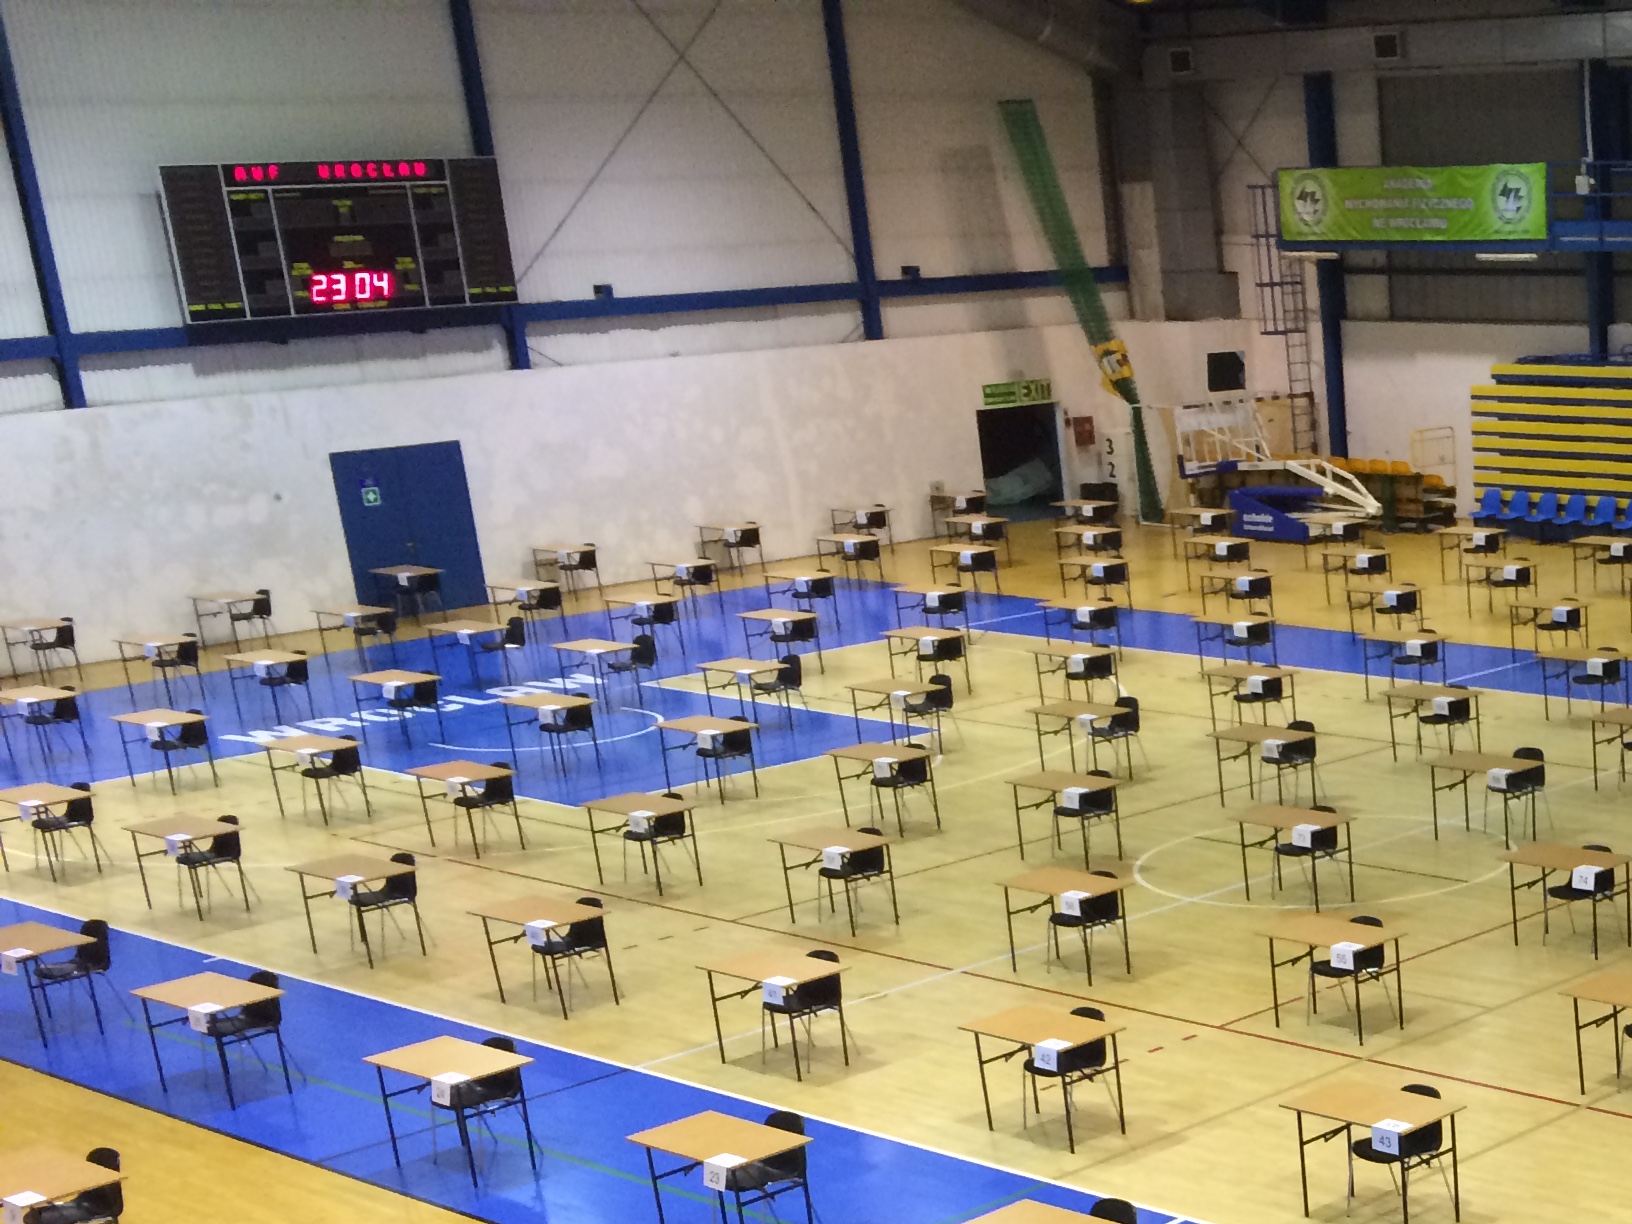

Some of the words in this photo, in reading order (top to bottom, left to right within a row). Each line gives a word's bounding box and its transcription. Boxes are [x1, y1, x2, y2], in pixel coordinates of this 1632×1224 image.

[1106, 437, 1114, 455] 3
[1107, 461, 1116, 478] 2
[1578, 875, 1588, 885] 74
[1040, 1054, 1051, 1065] 42
[1379, 1136, 1391, 1148] 43
[709, 1171, 719, 1184] 23
